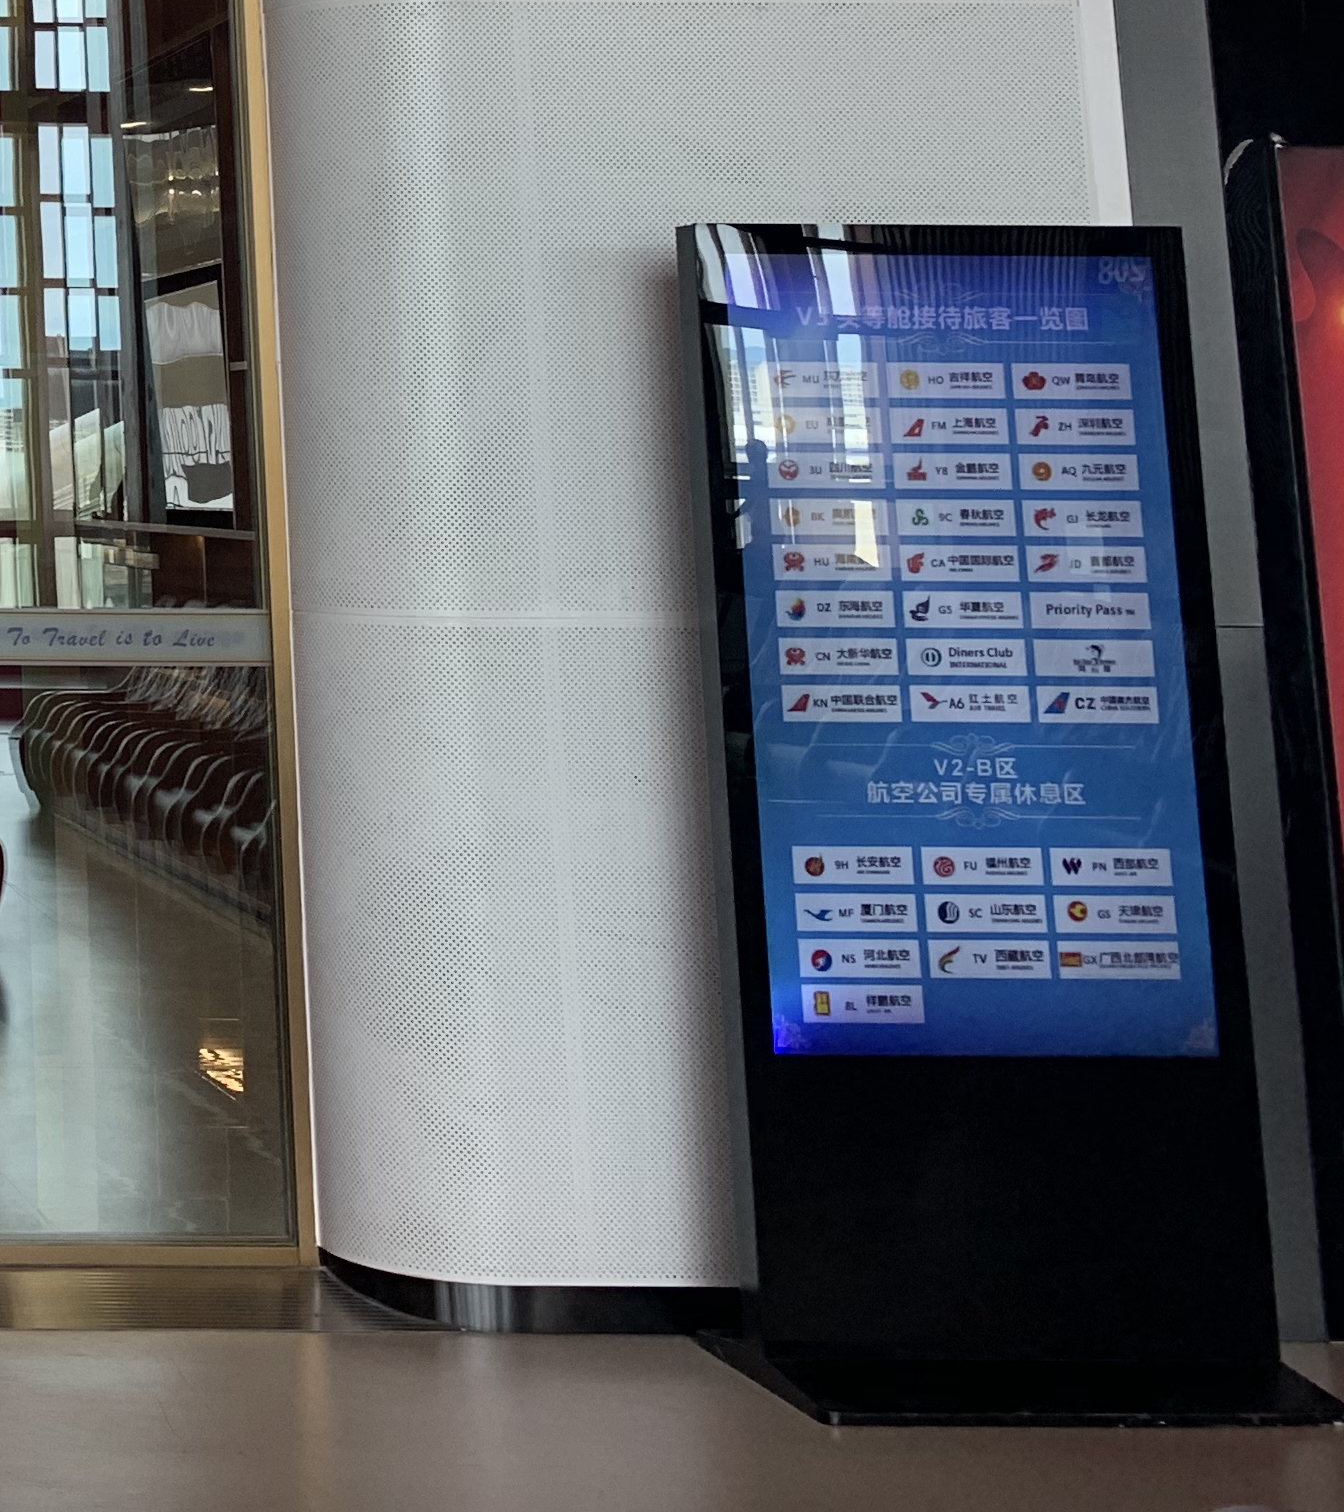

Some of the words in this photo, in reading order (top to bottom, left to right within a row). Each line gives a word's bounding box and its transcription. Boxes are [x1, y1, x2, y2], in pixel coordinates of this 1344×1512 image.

[802, 375, 820, 383] MU
[928, 376, 944, 385] HO
[949, 372, 994, 383] 吉祥航空
[1051, 376, 1070, 387] QW
[806, 420, 818, 429] EU
[931, 421, 946, 430] FM
[952, 417, 997, 428] 上海航空
[1058, 422, 1072, 431] ZH
[1078, 418, 1123, 429] 深圳航空
[935, 467, 948, 475] Y8
[1061, 467, 1077, 477] AQ
[1082, 463, 1126, 475] 九元航空
[811, 513, 825, 521] BK
[960, 509, 1004, 520] 春秋航空
[1085, 510, 1130, 522] 长龙航空
[814, 558, 829, 567] HU
[930, 559, 946, 568] CA
[948, 555, 1014, 566] 中国国际航空
[816, 603, 831, 612] DZ
[838, 600, 883, 612] 东海航空
[1046, 604, 1092, 618] Priority
[1095, 604, 1123, 616] Pass
[7, 627, 31, 645] To
[42, 627, 107, 646] Travel
[116, 631, 133, 646] is
[143, 629, 162, 646] to
[172, 629, 215, 646] Live
[815, 652, 830, 661] CN
[836, 648, 893, 660] 大新华航空
[948, 647, 985, 657] Diners
[987, 647, 1013, 657] Club
[813, 699, 828, 708] KN
[830, 694, 898, 706] 中国联合航空
[948, 698, 965, 709] A6
[1075, 697, 1096, 709] CZ
[932, 758, 1018, 778] V2-B区
[867, 781, 1086, 805] 航空公司专属休息区
[834, 861, 849, 869] 9H
[856, 856, 901, 868] 长安航空
[963, 862, 977, 871] FU
[1092, 862, 1107, 871] PN
[1113, 858, 1159, 870] 西部航空
[838, 909, 854, 917] MF
[860, 903, 908, 916] 厦门航空
[969, 909, 983, 918] SC
[990, 904, 1037, 916] 山东航空
[1097, 910, 1111, 920] GS
[1118, 905, 1164, 917] 天津航空
[841, 954, 857, 963] NS
[863, 949, 911, 961] 河北航空
[972, 954, 987, 964] TV
[1083, 955, 1098, 965] GX
